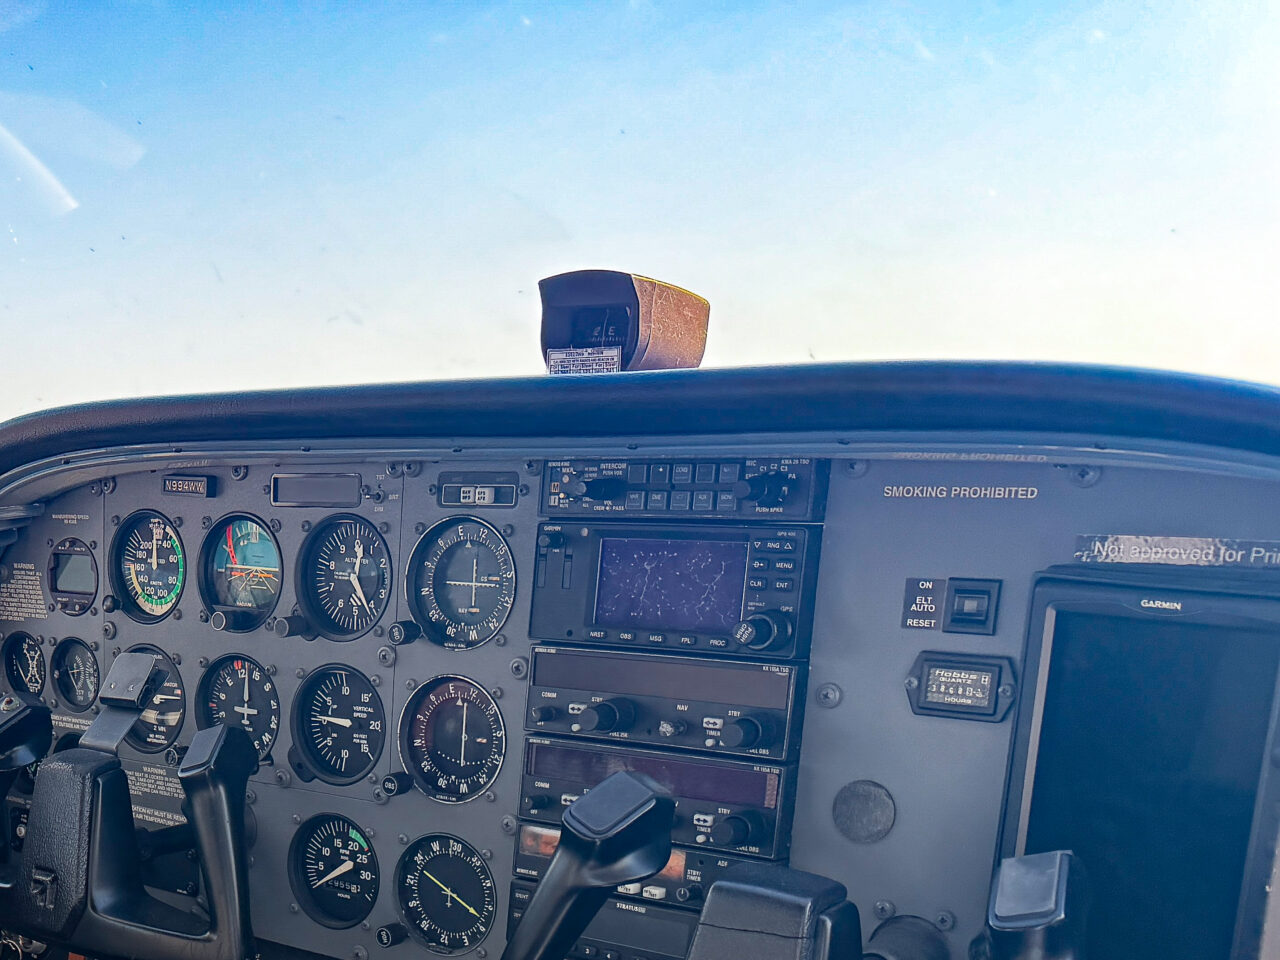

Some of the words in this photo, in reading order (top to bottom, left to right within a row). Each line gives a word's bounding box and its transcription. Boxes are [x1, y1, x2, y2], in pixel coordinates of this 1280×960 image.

[166, 481, 204, 493] N994WW
[884, 486, 947, 498] SMOKING
[951, 487, 1038, 499] PROHIBITED
[458, 526, 464, 536] E
[480, 528, 488, 538] 12
[438, 538, 444, 546] 6
[340, 545, 346, 554] 9
[500, 544, 508, 555] 15
[1093, 541, 1124, 557] Not
[1130, 545, 1214, 562] approved
[1220, 545, 1247, 562] for
[1250, 548, 1280, 565] Pri
[137, 551, 146, 559] 180
[329, 561, 335, 569] 8
[380, 559, 387, 567] 2
[138, 575, 148, 583] 140
[168, 576, 176, 584] 80
[919, 581, 933, 590] ON
[158, 589, 167, 597] 100
[379, 590, 385, 598] 3
[338, 600, 344, 608] 6
[916, 596, 932, 604] ELT
[911, 604, 936, 612] AUTO
[1141, 600, 1182, 611] GARMIN
[353, 607, 358, 615] 5
[429, 610, 438, 622] 33
[907, 619, 936, 628] RESET
[447, 627, 456, 637] 30
[470, 630, 478, 641] W
[238, 670, 246, 678] 12
[252, 670, 261, 681] 15
[936, 670, 978, 680] Hobbs
[226, 678, 234, 687] E
[264, 683, 272, 692] S
[342, 687, 350, 696] 10
[450, 684, 455, 693] E
[470, 688, 477, 698] 12
[327, 698, 332, 706] 5
[361, 694, 369, 702] 15
[488, 704, 495, 714] 15
[370, 721, 381, 730] 20
[327, 738, 333, 746] 5
[361, 744, 369, 753] 15
[341, 750, 349, 758] 10
[143, 766, 167, 775] WARNING
[438, 778, 447, 788] 30
[535, 781, 550, 789] COMM
[460, 783, 468, 793] W
[334, 838, 343, 848] 15
[348, 841, 359, 851] 20
[431, 841, 440, 852] W
[453, 843, 462, 852] 30
[322, 847, 331, 857] 10
[357, 853, 368, 864] 25
[318, 862, 324, 871] 5
[360, 871, 371, 881] 30
